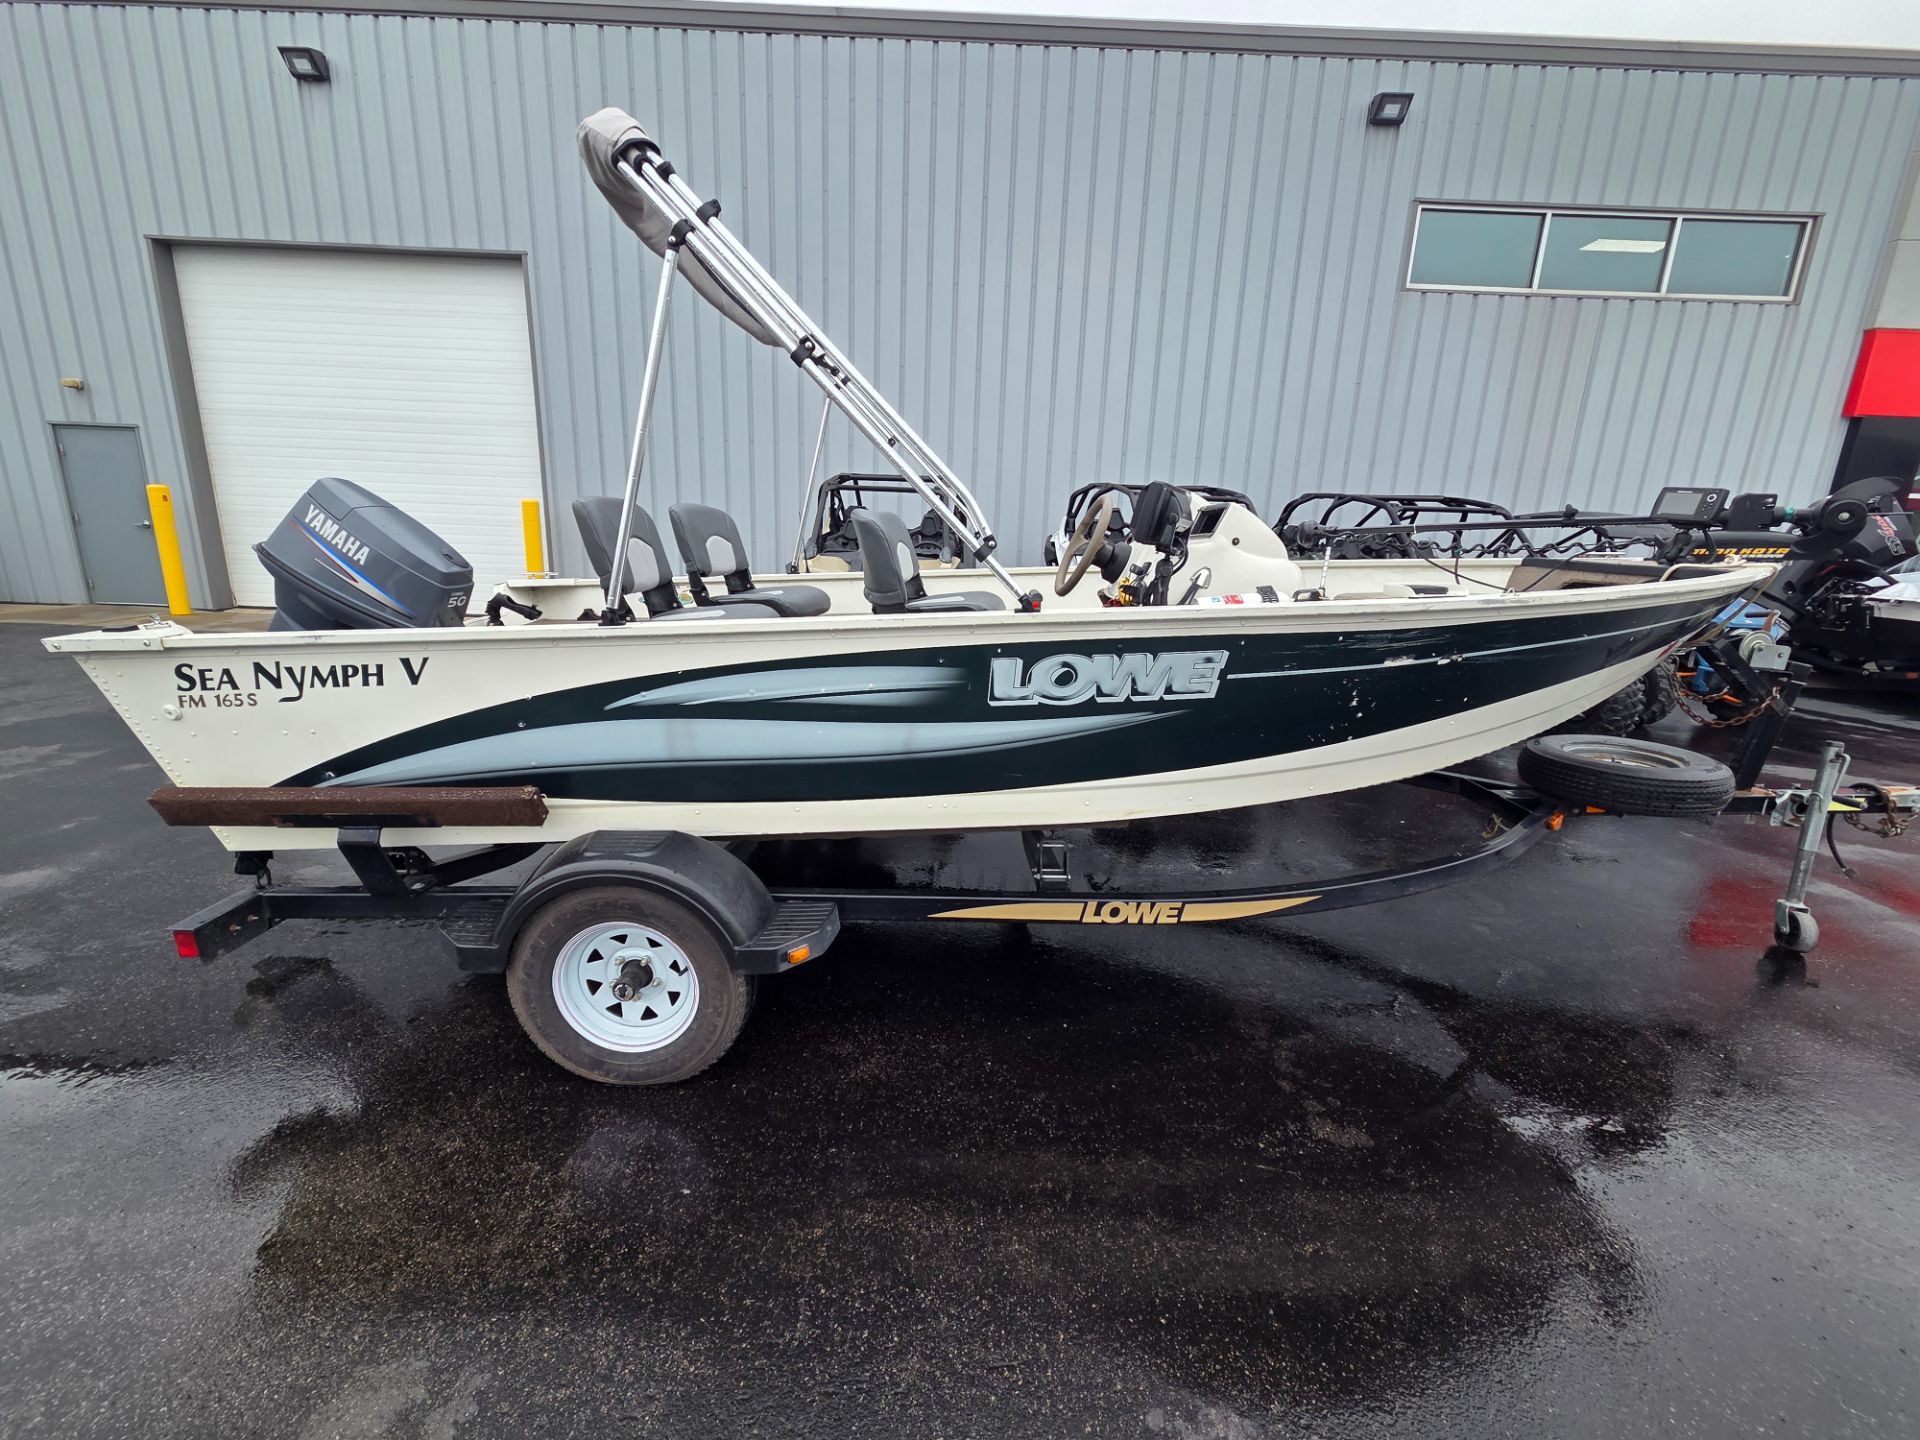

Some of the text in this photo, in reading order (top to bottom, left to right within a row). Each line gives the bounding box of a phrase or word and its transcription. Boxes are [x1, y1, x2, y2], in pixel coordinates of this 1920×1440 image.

[304, 503, 371, 566] YAMAHA
[1739, 547, 1791, 555] KOTA
[447, 595, 467, 608] 50
[174, 662, 240, 692] SEA
[399, 656, 430, 686] V
[987, 649, 1230, 707] LOWE
[178, 694, 207, 709] FM
[1081, 900, 1183, 924] LOWE
